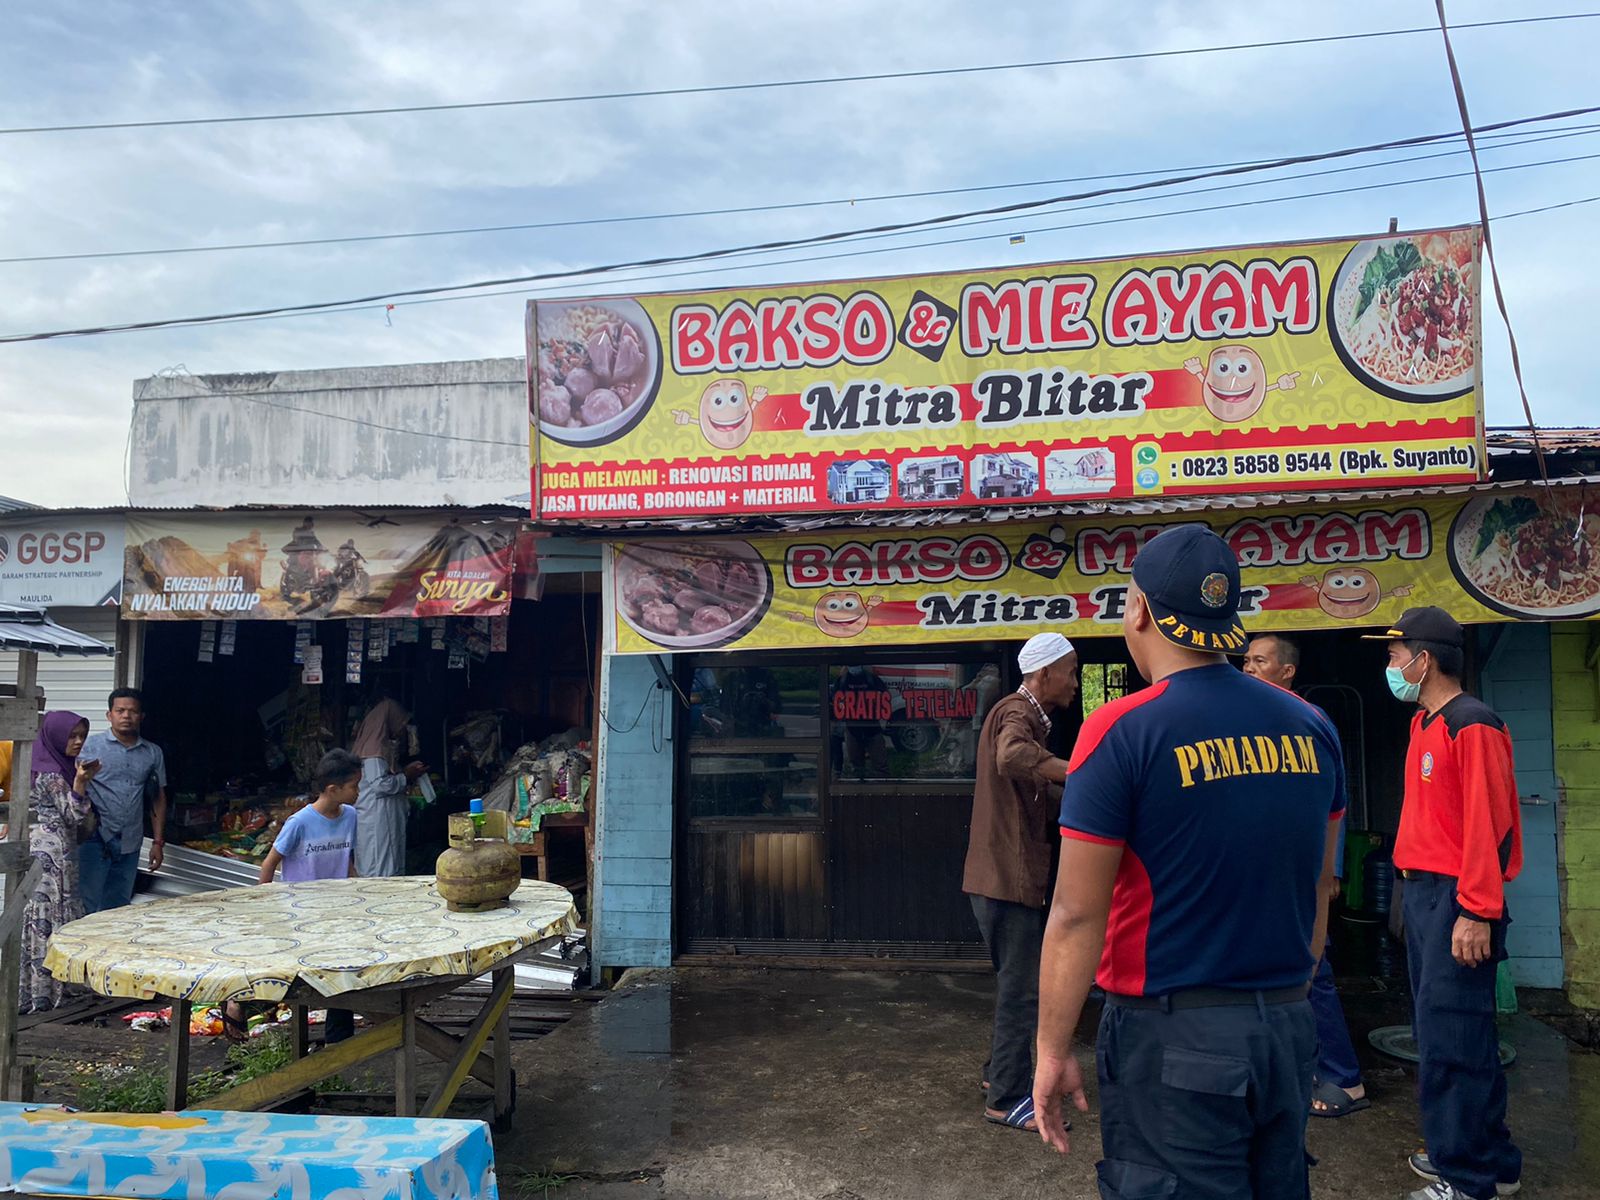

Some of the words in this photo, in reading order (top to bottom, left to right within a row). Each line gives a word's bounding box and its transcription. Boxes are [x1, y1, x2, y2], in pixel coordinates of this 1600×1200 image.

[674, 295, 891, 371] BAKSO
[902, 299, 950, 349] &
[962, 277, 1096, 353] MIE
[1106, 259, 1317, 343] AYAM
[805, 379, 957, 432] Mitra
[977, 369, 1148, 424] Blitar
[541, 472, 580, 490] JUGA
[583, 469, 658, 488] MELAYANI
[668, 465, 748, 485] RENOVASI
[751, 462, 816, 483] RUMAH,
[1182, 456, 1229, 478] 0823
[1234, 454, 1280, 475] 5858
[1285, 451, 1332, 472] 9544
[1339, 449, 1388, 474] (Bpk.
[1393, 445, 1476, 471] Suyanto)
[541, 494, 577, 513] JASA
[579, 492, 641, 512] TUKANG,
[644, 489, 726, 509] BORONGAN
[743, 486, 816, 506] MATERIAL
[17, 531, 105, 565] GGSP
[786, 536, 1010, 588] BAKSO
[1022, 540, 1065, 572] &
[1228, 508, 1430, 567] AYAM
[24, 571, 58, 579] STRATEGIC
[59, 570, 103, 579] PARTNERSHIP
[163, 576, 212, 592] ENERGI
[20, 594, 53, 603] MAULIDA
[130, 592, 209, 611] NYALAKAN
[210, 592, 260, 611] HIDUP
[416, 571, 507, 613] Surya
[920, 591, 1076, 628] Mitra
[834, 690, 892, 720] GRATIS
[902, 688, 978, 719] TETELAN
[1173, 733, 1320, 788] PEMADAM
